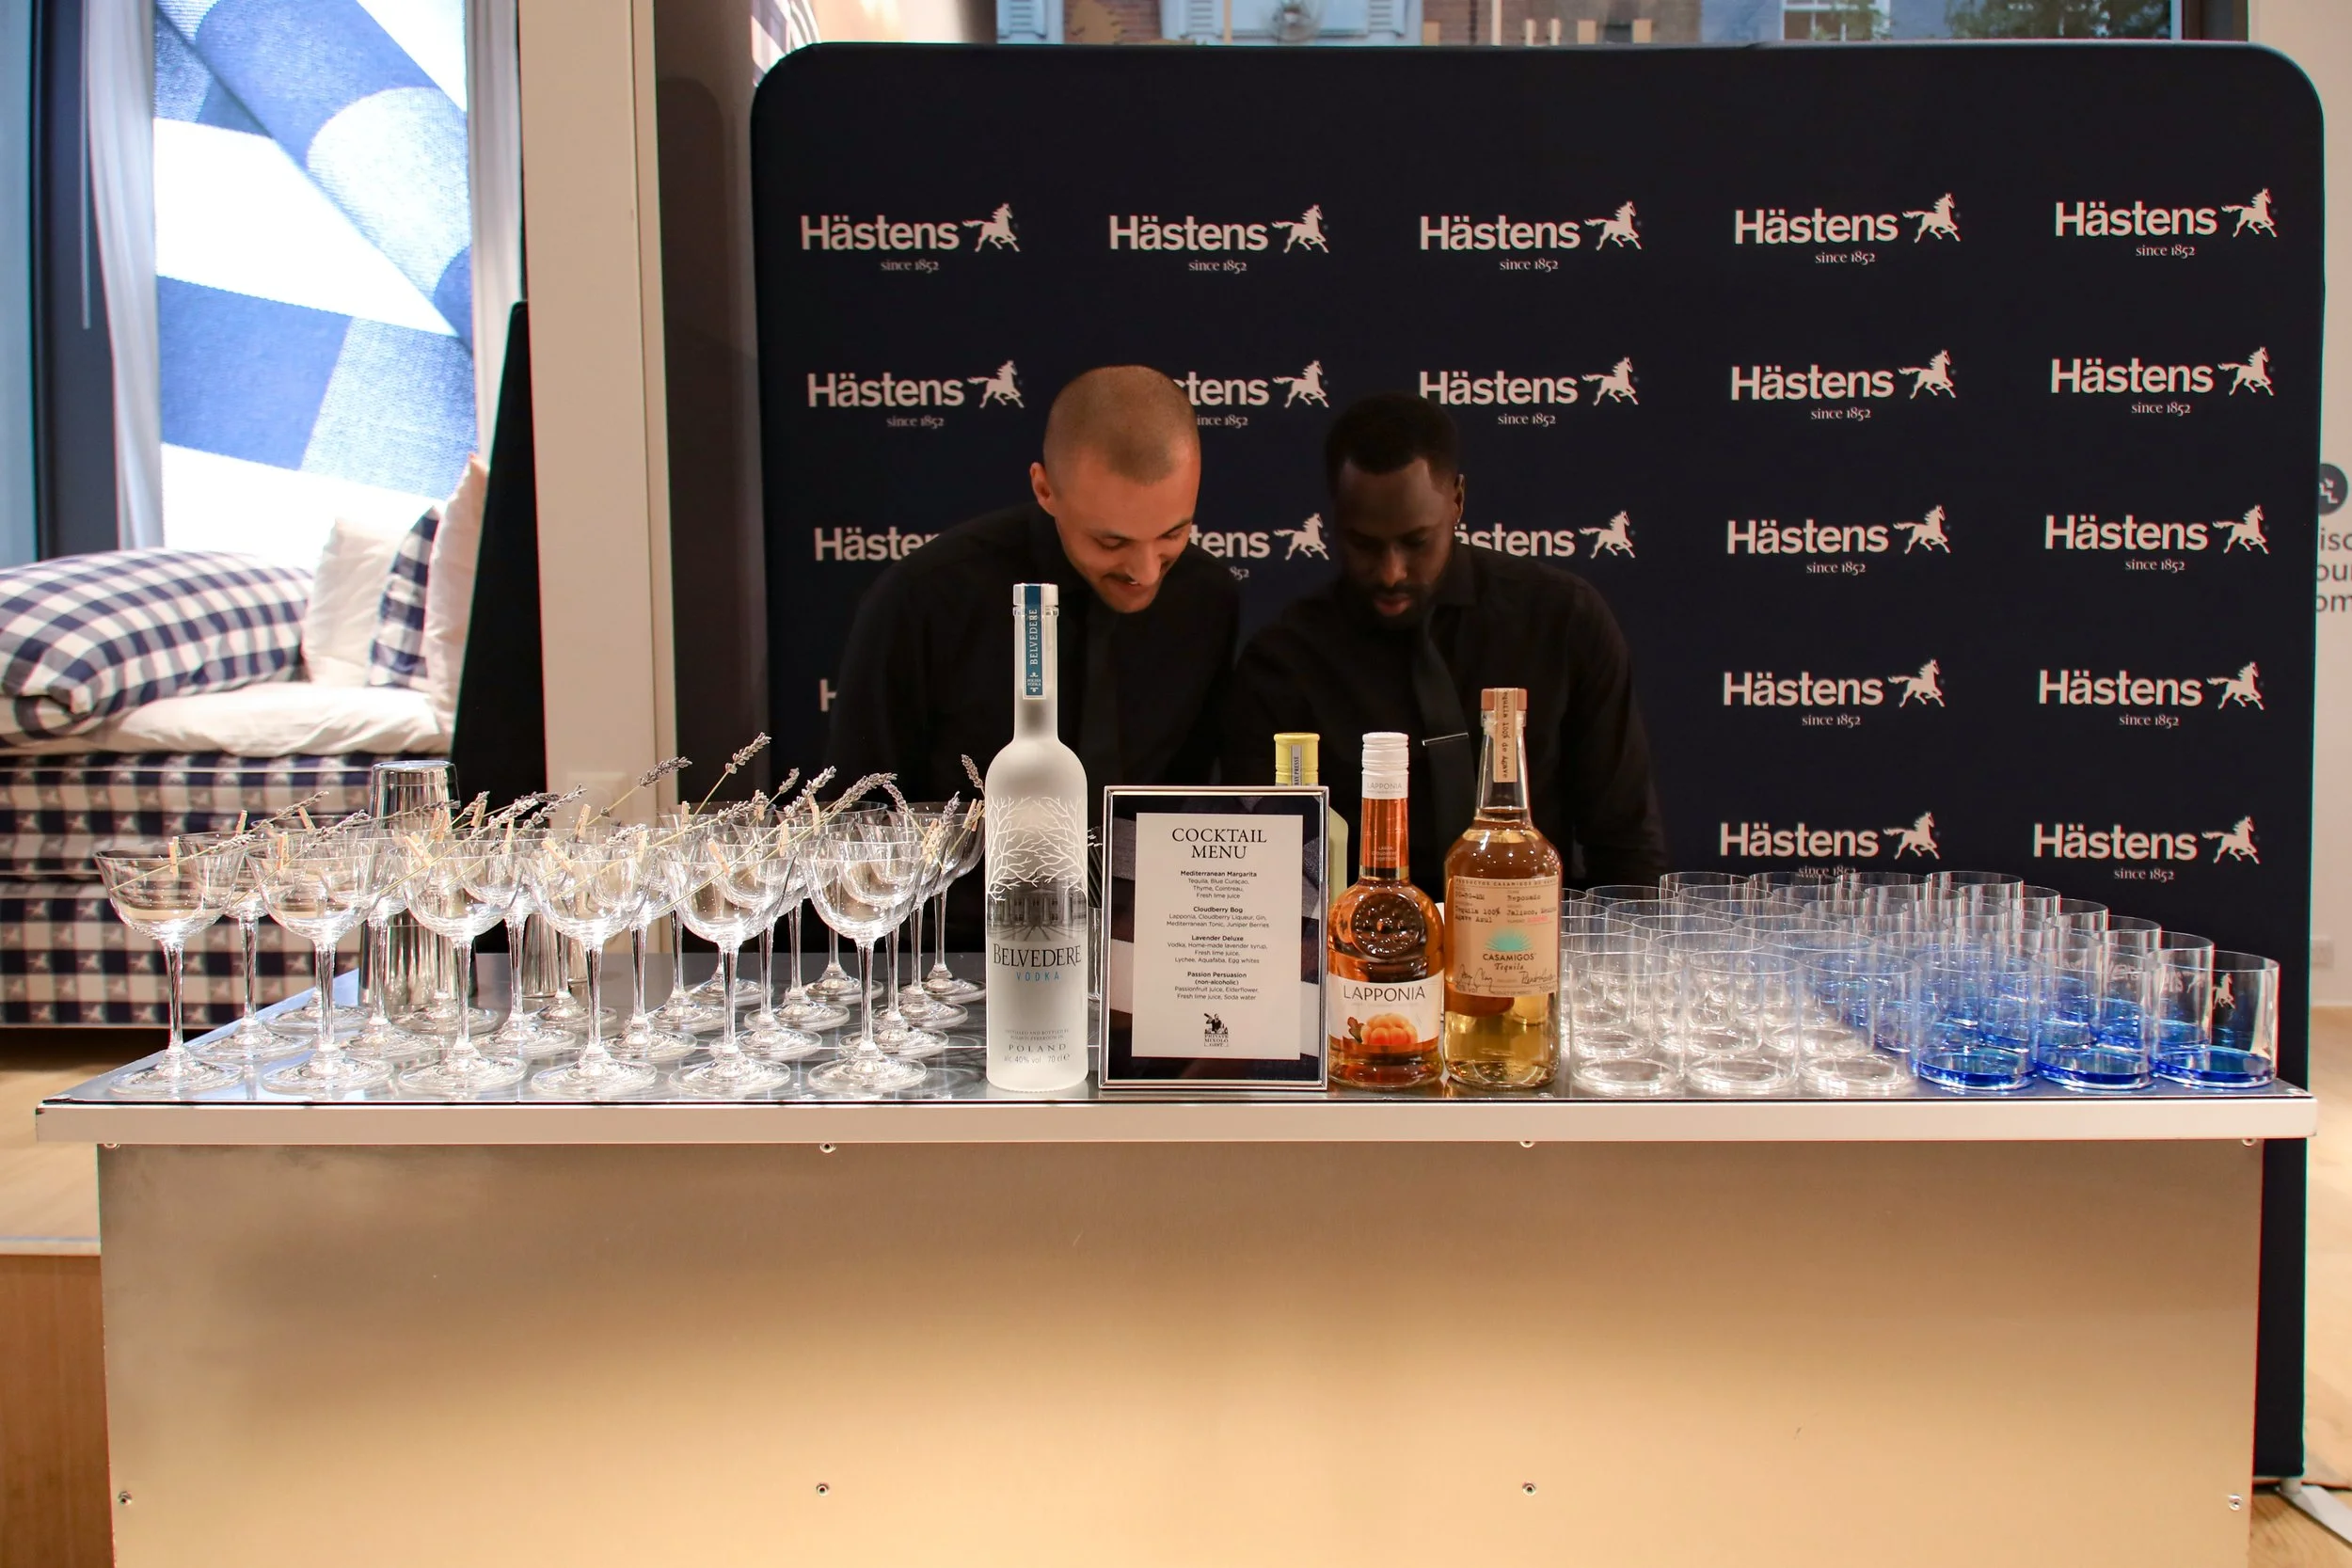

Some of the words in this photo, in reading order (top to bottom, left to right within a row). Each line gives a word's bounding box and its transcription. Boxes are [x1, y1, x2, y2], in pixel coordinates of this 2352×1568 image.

[1736, 208, 1898, 244] Hästens
[2056, 201, 2217, 236] Hästens
[802, 215, 959, 250] Hästens
[1110, 215, 1268, 250] Hästens
[1421, 215, 1581, 250] Hästens
[1816, 252, 1847, 263] since
[1851, 251, 1875, 265] 1852
[2137, 245, 2168, 256] since
[2171, 244, 2195, 259] 1852
[882, 260, 912, 271] since
[915, 260, 938, 273] 1852
[1189, 260, 1219, 271] since
[1223, 260, 1247, 274] 1852
[1500, 259, 1531, 270] since
[1534, 259, 1558, 272] 1852
[1732, 365, 1894, 400] Hästens
[2051, 358, 2213, 393] Hästens
[809, 372, 964, 406] Hästens
[1173, 371, 1269, 405] tens
[1420, 371, 1578, 404] Hästens
[1811, 408, 1843, 420] since
[1847, 407, 1870, 421] 1852
[2132, 402, 2163, 413] since
[2167, 402, 2190, 417] 1852
[887, 416, 916, 427] since
[921, 416, 944, 429] 1852
[1197, 415, 1221, 425] ince
[1225, 415, 1248, 428] 1852
[1498, 414, 1529, 424] since
[1533, 413, 1555, 427] 1852
[1454, 523, 1575, 556] ästens
[1727, 519, 1888, 554] Hästens
[2045, 515, 2207, 550] Hästens
[815, 527, 939, 561] Häste
[1189, 525, 1270, 558] tens
[1230, 566, 1249, 580] 852
[1806, 562, 1837, 573] since
[1841, 561, 1866, 576] 1852
[2125, 559, 2157, 570] since
[2161, 559, 2185, 573] 1852
[1029, 609, 1039, 665] BELVEDERE
[1724, 673, 1883, 705] Hästens
[2040, 670, 2201, 706] Hästens
[1803, 715, 1833, 725] since
[1837, 714, 1860, 728] 1852
[2120, 714, 2151, 725] since
[2155, 714, 2179, 729] 1852
[1171, 828, 1267, 843] COCKTAIL
[1721, 823, 1878, 857] Hästens
[2034, 824, 2197, 860] Hästens
[1190, 846, 1247, 859] MENU
[2115, 868, 2146, 879] since
[2150, 868, 2173, 882] 1852
[993, 943, 1082, 967] BELVEDERE
[1494, 962, 1525, 973] Tequila
[1016, 972, 1060, 982] VODKA
[1343, 985, 1426, 1002] LAPPONIA
[1009, 1043, 1066, 1053] POLAND
